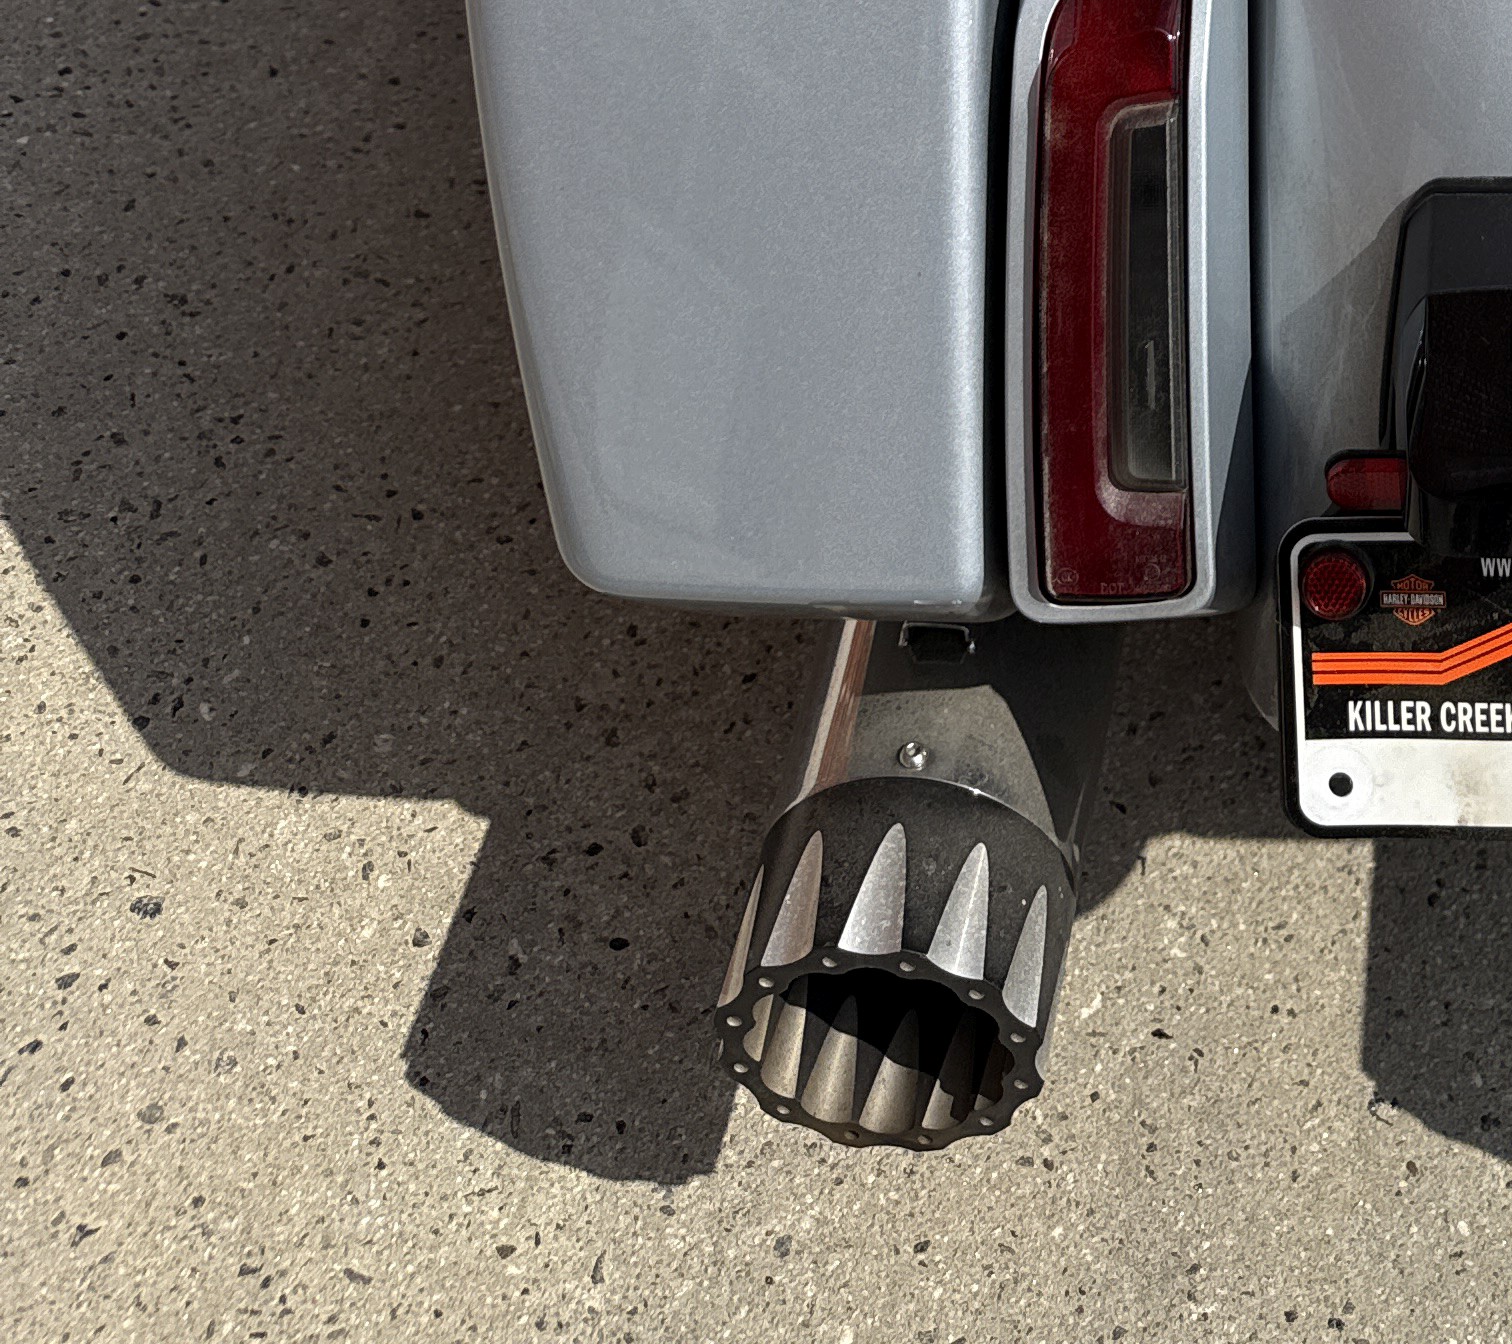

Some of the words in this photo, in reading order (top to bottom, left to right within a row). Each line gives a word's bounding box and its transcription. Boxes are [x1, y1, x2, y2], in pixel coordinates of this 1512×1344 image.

[1397, 577, 1429, 590] MOTOR
[1383, 593, 1444, 606] HARLEY-DAVIDSON
[1397, 607, 1430, 622] CYCLES
[1347, 700, 1432, 732] KILLER
